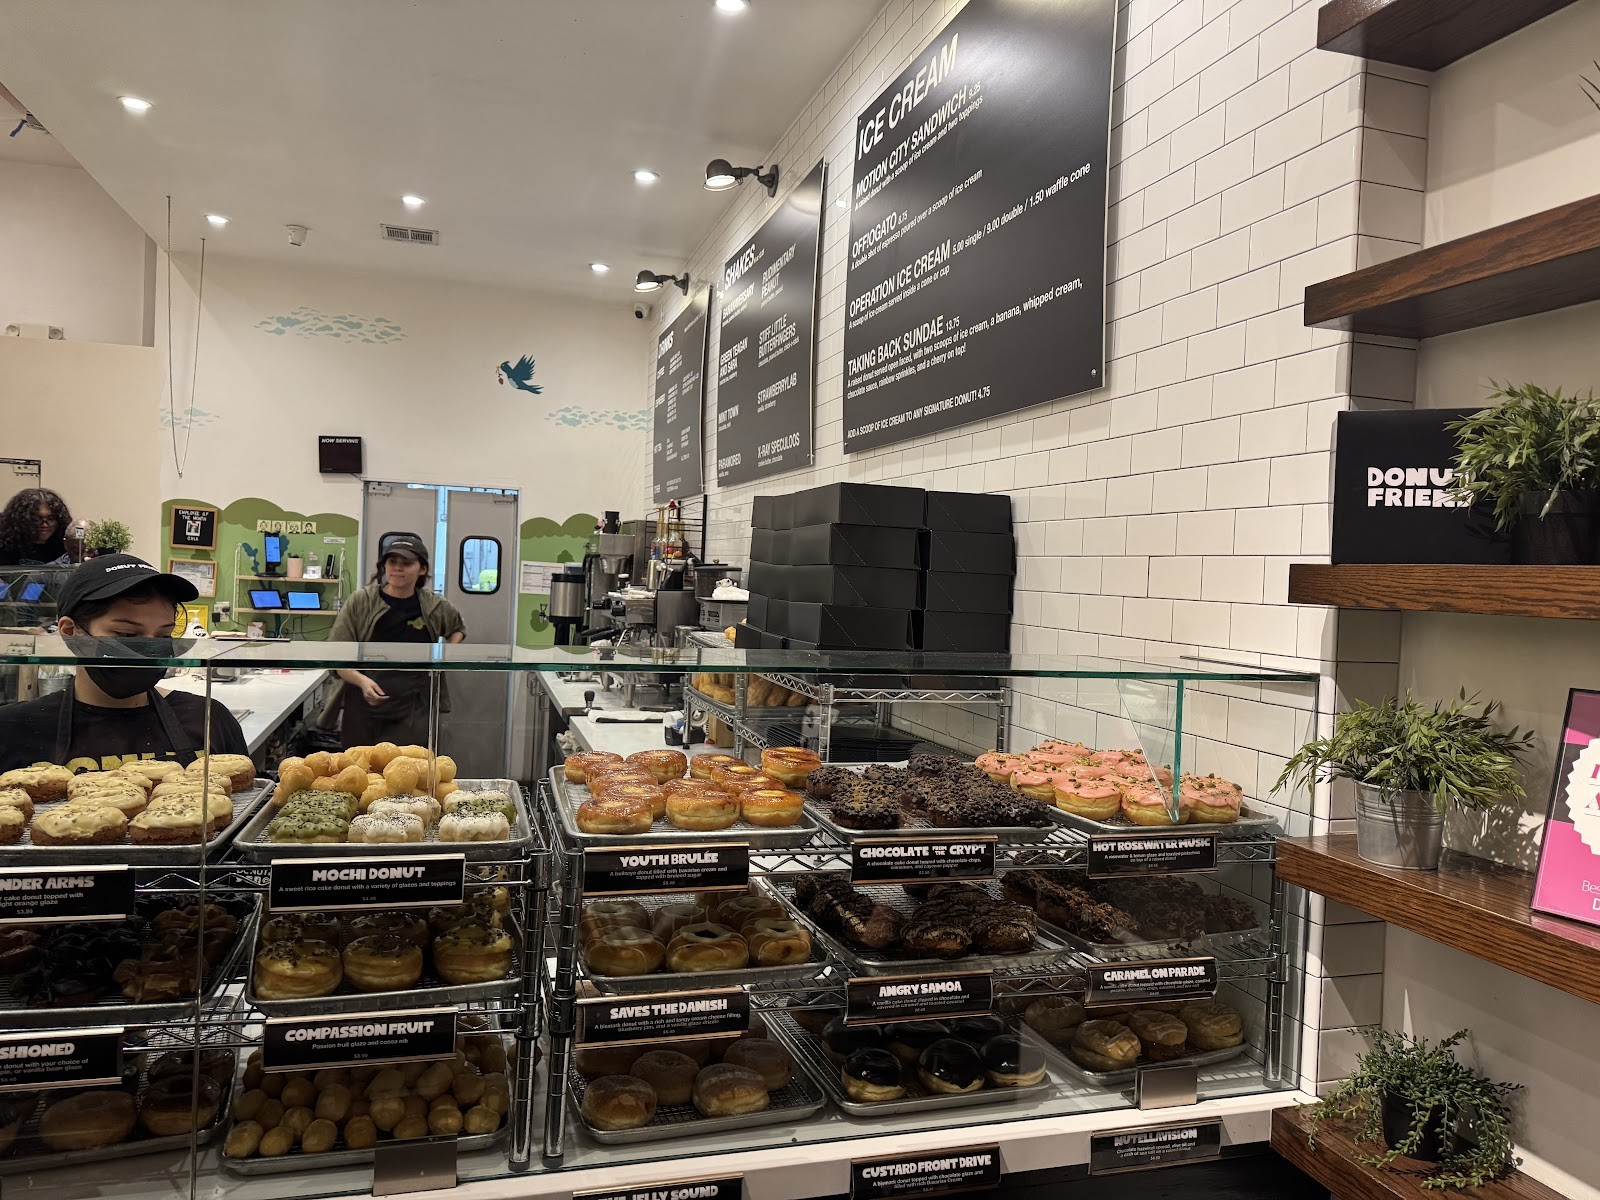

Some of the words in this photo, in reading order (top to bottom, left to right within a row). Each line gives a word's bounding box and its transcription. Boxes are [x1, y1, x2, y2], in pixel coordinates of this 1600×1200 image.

[858, 107, 886, 160] ICE
[888, 32, 959, 129] CREAM
[855, 157, 888, 200] MOTION
[889, 136, 910, 170] CITY
[910, 84, 967, 151] SANDWICH
[968, 80, 981, 99] 9.25
[849, 274, 895, 318] OPERATION
[897, 264, 912, 290] ICE
[913, 238, 951, 279] CREAM
[952, 240, 964, 255] 5.00
[964, 229, 982, 247] single
[982, 225, 986, 237] /
[986, 217, 1000, 234] 9.00
[1000, 204, 1023, 226] double
[1024, 198, 1028, 211] /
[1029, 189, 1044, 208] 1.50
[1045, 175, 1069, 198] waffle
[1070, 162, 1091, 182] cone
[724, 244, 756, 290] SHAKES
[761, 272, 780, 298] PEANUT
[759, 325, 771, 345] STIFF
[771, 313, 787, 337] LITTLE
[759, 322, 796, 359] BUTTERFINGERS
[847, 348, 876, 377] TAKING
[877, 335, 902, 364] BACK
[903, 315, 944, 352] SUNDAE
[946, 316, 960, 332] 13.75
[757, 372, 797, 404] STRAWBERRYLAB
[847, 427, 856, 438] ADD
[856, 426, 860, 436] A
[860, 422, 875, 435] SCOOP
[875, 421, 881, 430] OF
[880, 419, 888, 430] ICE
[888, 412, 906, 427] CREAM
[905, 411, 913, 421] TO
[913, 407, 924, 419] ANY
[924, 397, 954, 416] SIGNATURE
[954, 389, 977, 405] DONUT!
[977, 385, 991, 399] 4.75
[757, 441, 771, 459] X-RAY
[771, 432, 800, 454] SPECULOOS
[1368, 488, 1474, 508] FRIEND
[106, 563, 137, 573] DONUT
[860, 846, 929, 859] CHOCOLATE
[949, 844, 987, 855] CRYPT
[1092, 841, 1117, 852] HOT
[1117, 838, 1178, 852] ROSEWATER
[1178, 837, 1211, 848] MUSIC
[619, 854, 669, 868] YOUTH
[671, 850, 719, 865] BRULÉE
[45, 876, 95, 889] ARMS
[312, 868, 366, 882] MOCHI
[369, 866, 425, 880] DONUT
[14, 899, 38, 907] orange
[22, 893, 42, 901] donut
[44, 892, 68, 901] topped
[1103, 968, 1152, 982] CARAMEL
[1151, 967, 1168, 979] ON
[1168, 966, 1206, 977] PARADE
[879, 984, 920, 998] ANGRY
[920, 980, 962, 994] SAMOA
[609, 1005, 650, 1020] SAVES
[651, 1002, 679, 1016] THE
[679, 998, 728, 1014] DANISH
[284, 1023, 389, 1042] COMPASSION
[389, 1020, 434, 1035] FRUIT
[1113, 1127, 1198, 1147] NUTELLAVISION
[862, 1162, 917, 1179] CUSTARD
[918, 1158, 959, 1173] FRONT
[959, 1154, 992, 1168] DRIVE
[670, 1185, 719, 1200] SOUND
